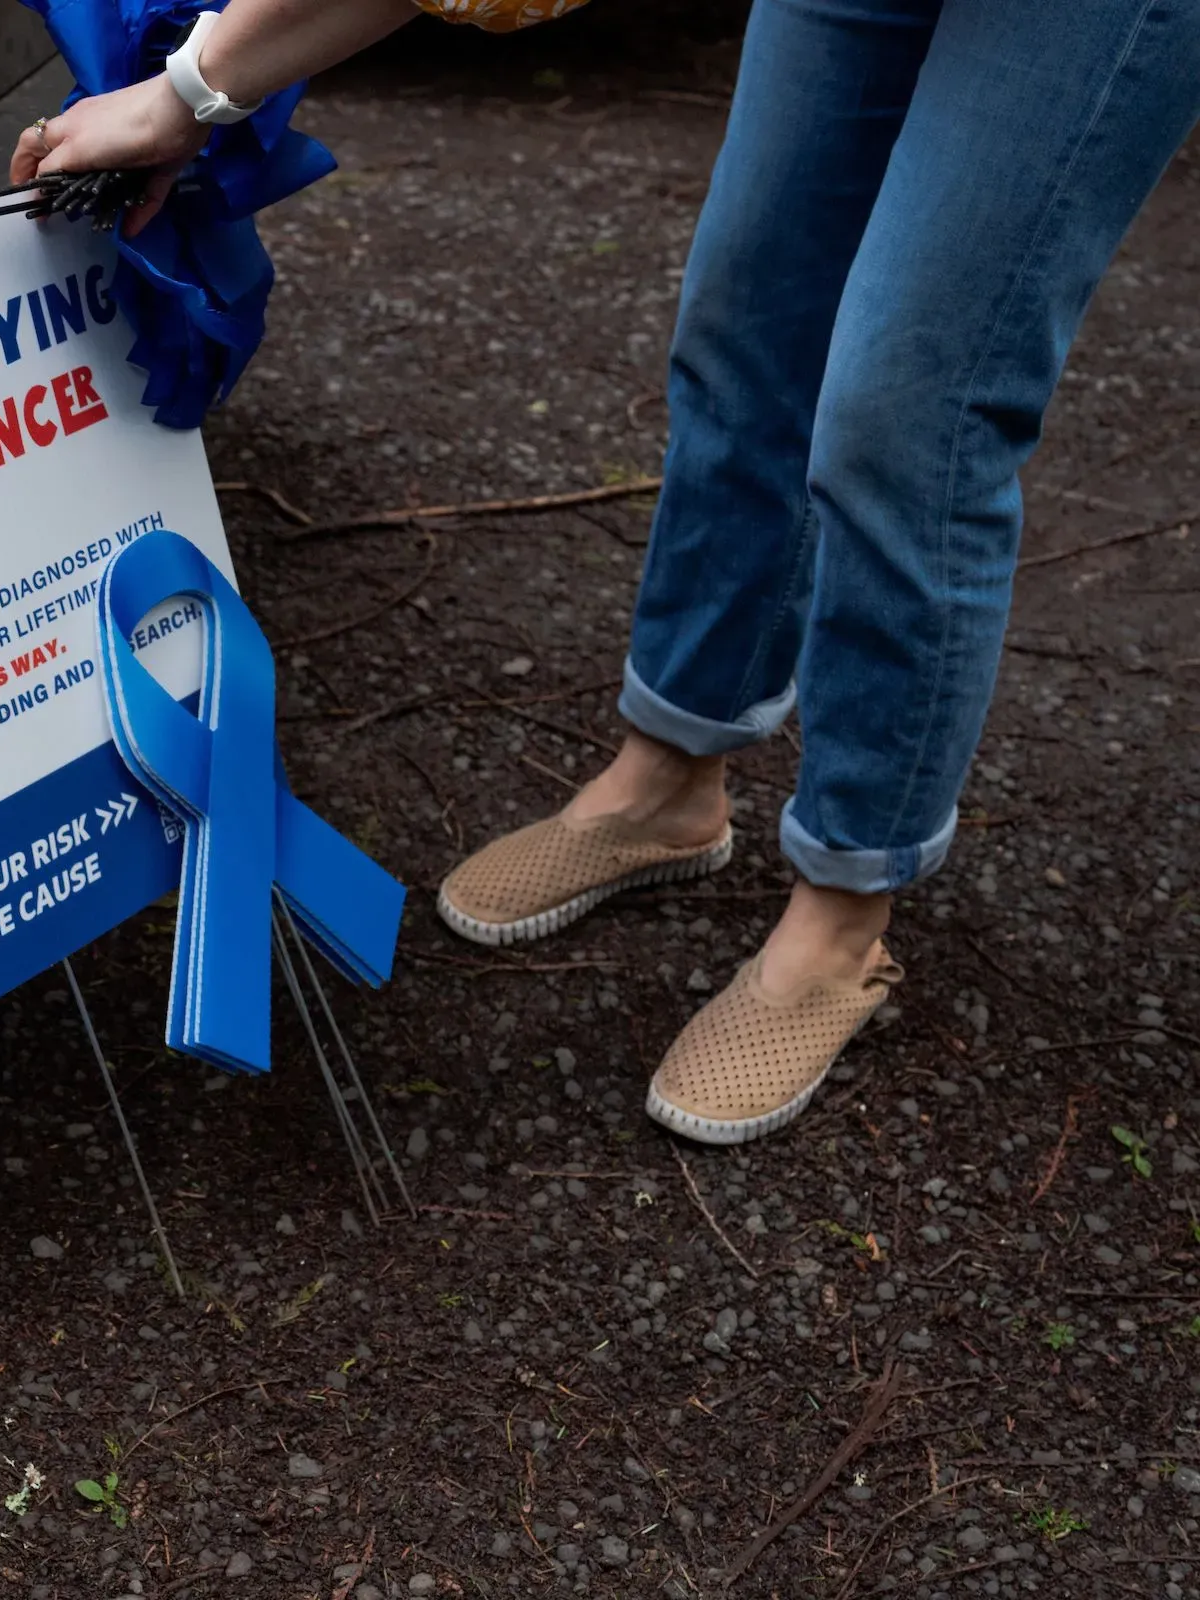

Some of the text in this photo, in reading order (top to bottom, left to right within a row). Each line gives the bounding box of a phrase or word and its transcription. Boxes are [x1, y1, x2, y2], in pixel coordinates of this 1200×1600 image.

[115, 510, 164, 546] WITH
[10, 639, 66, 676] WAY.
[54, 659, 94, 694] AND
[32, 814, 90, 869] RISK
[20, 853, 101, 920] CAUSE
